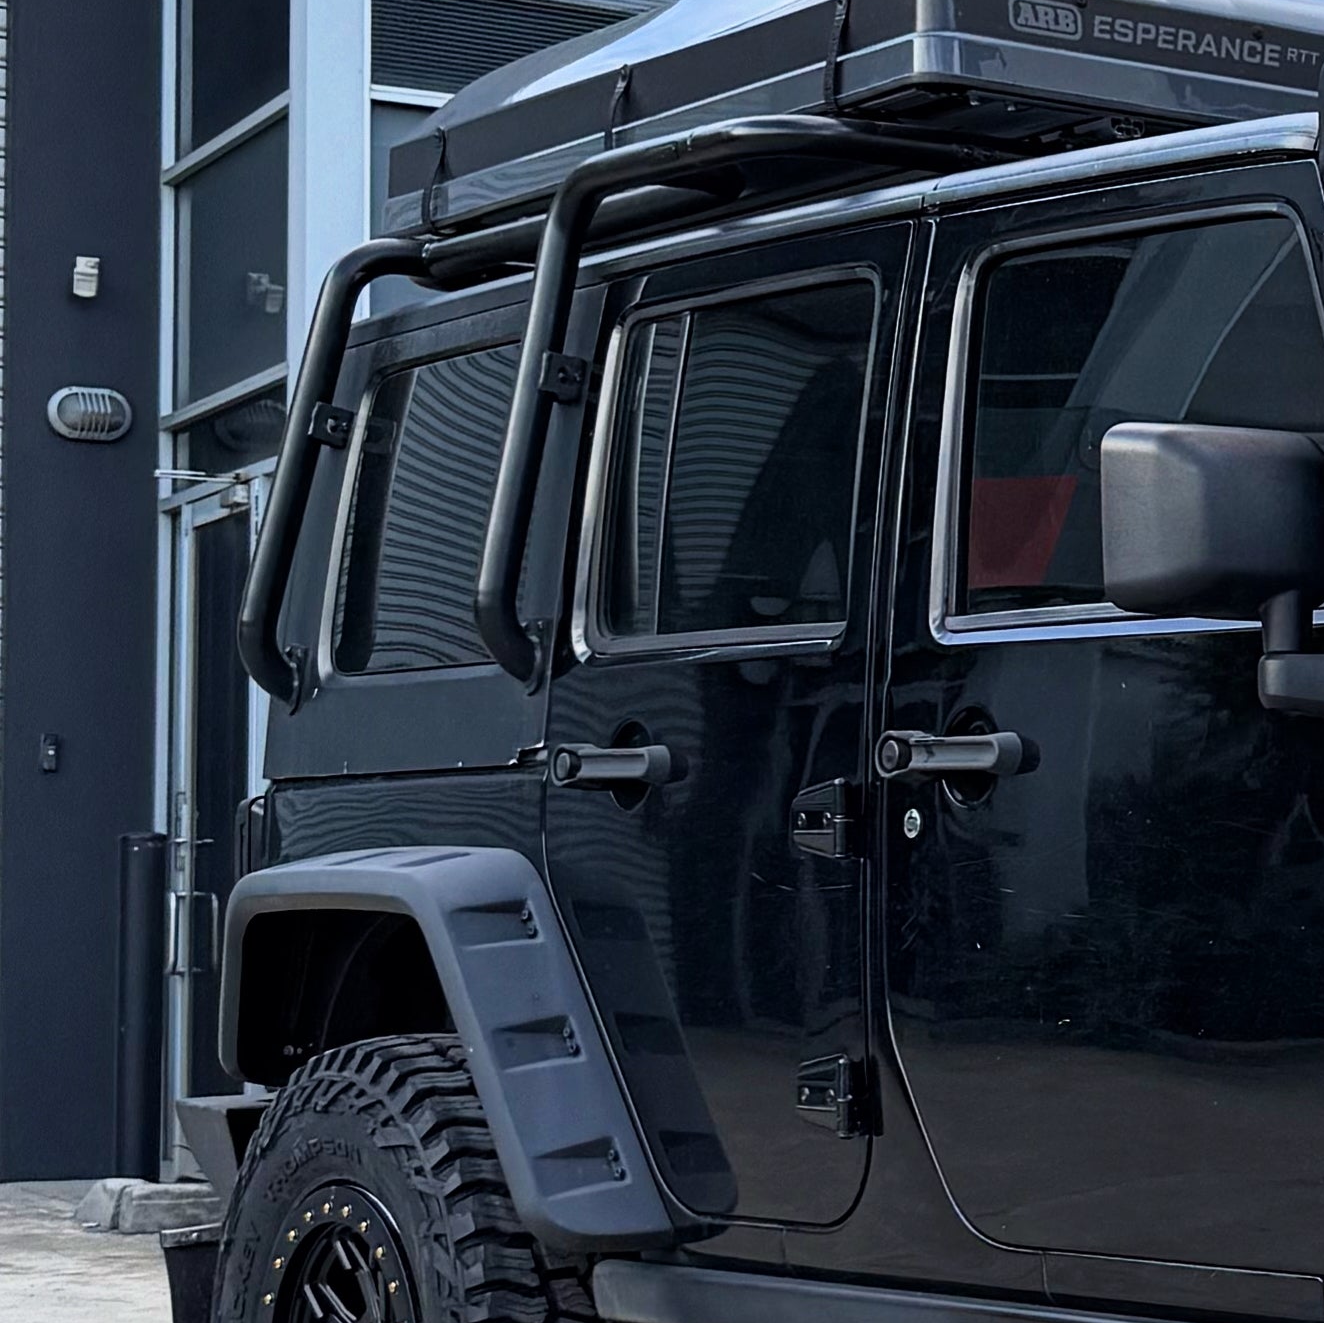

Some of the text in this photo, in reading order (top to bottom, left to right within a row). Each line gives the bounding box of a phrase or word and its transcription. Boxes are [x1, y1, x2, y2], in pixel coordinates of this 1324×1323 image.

[1016, 0, 1321, 68] ARB ESPERANCE RTT
